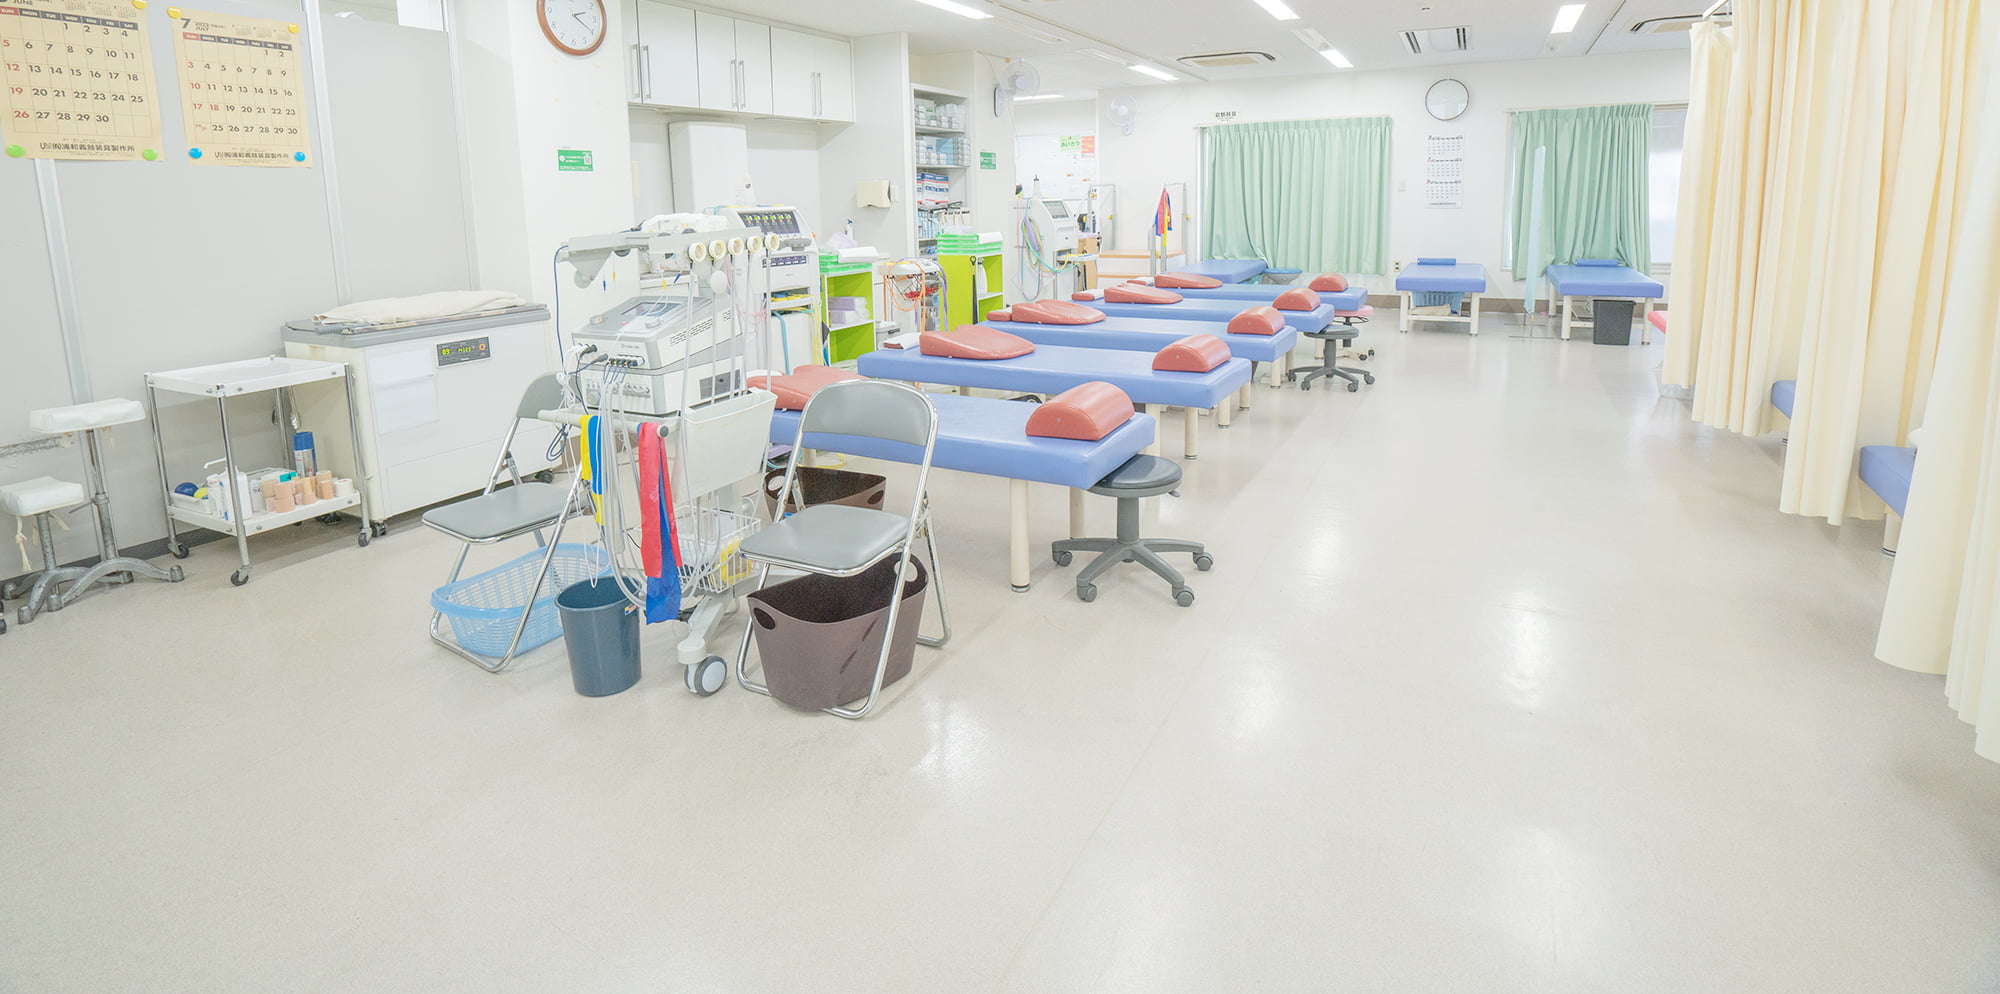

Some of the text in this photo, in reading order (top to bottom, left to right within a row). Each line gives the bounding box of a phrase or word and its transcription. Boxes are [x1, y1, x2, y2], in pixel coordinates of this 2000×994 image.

[180, 18, 191, 29] 7
[552, 21, 556, 29] 8
[560, 32, 565, 40] 7
[7, 63, 19, 71] 12
[32, 88, 47, 96] 20
